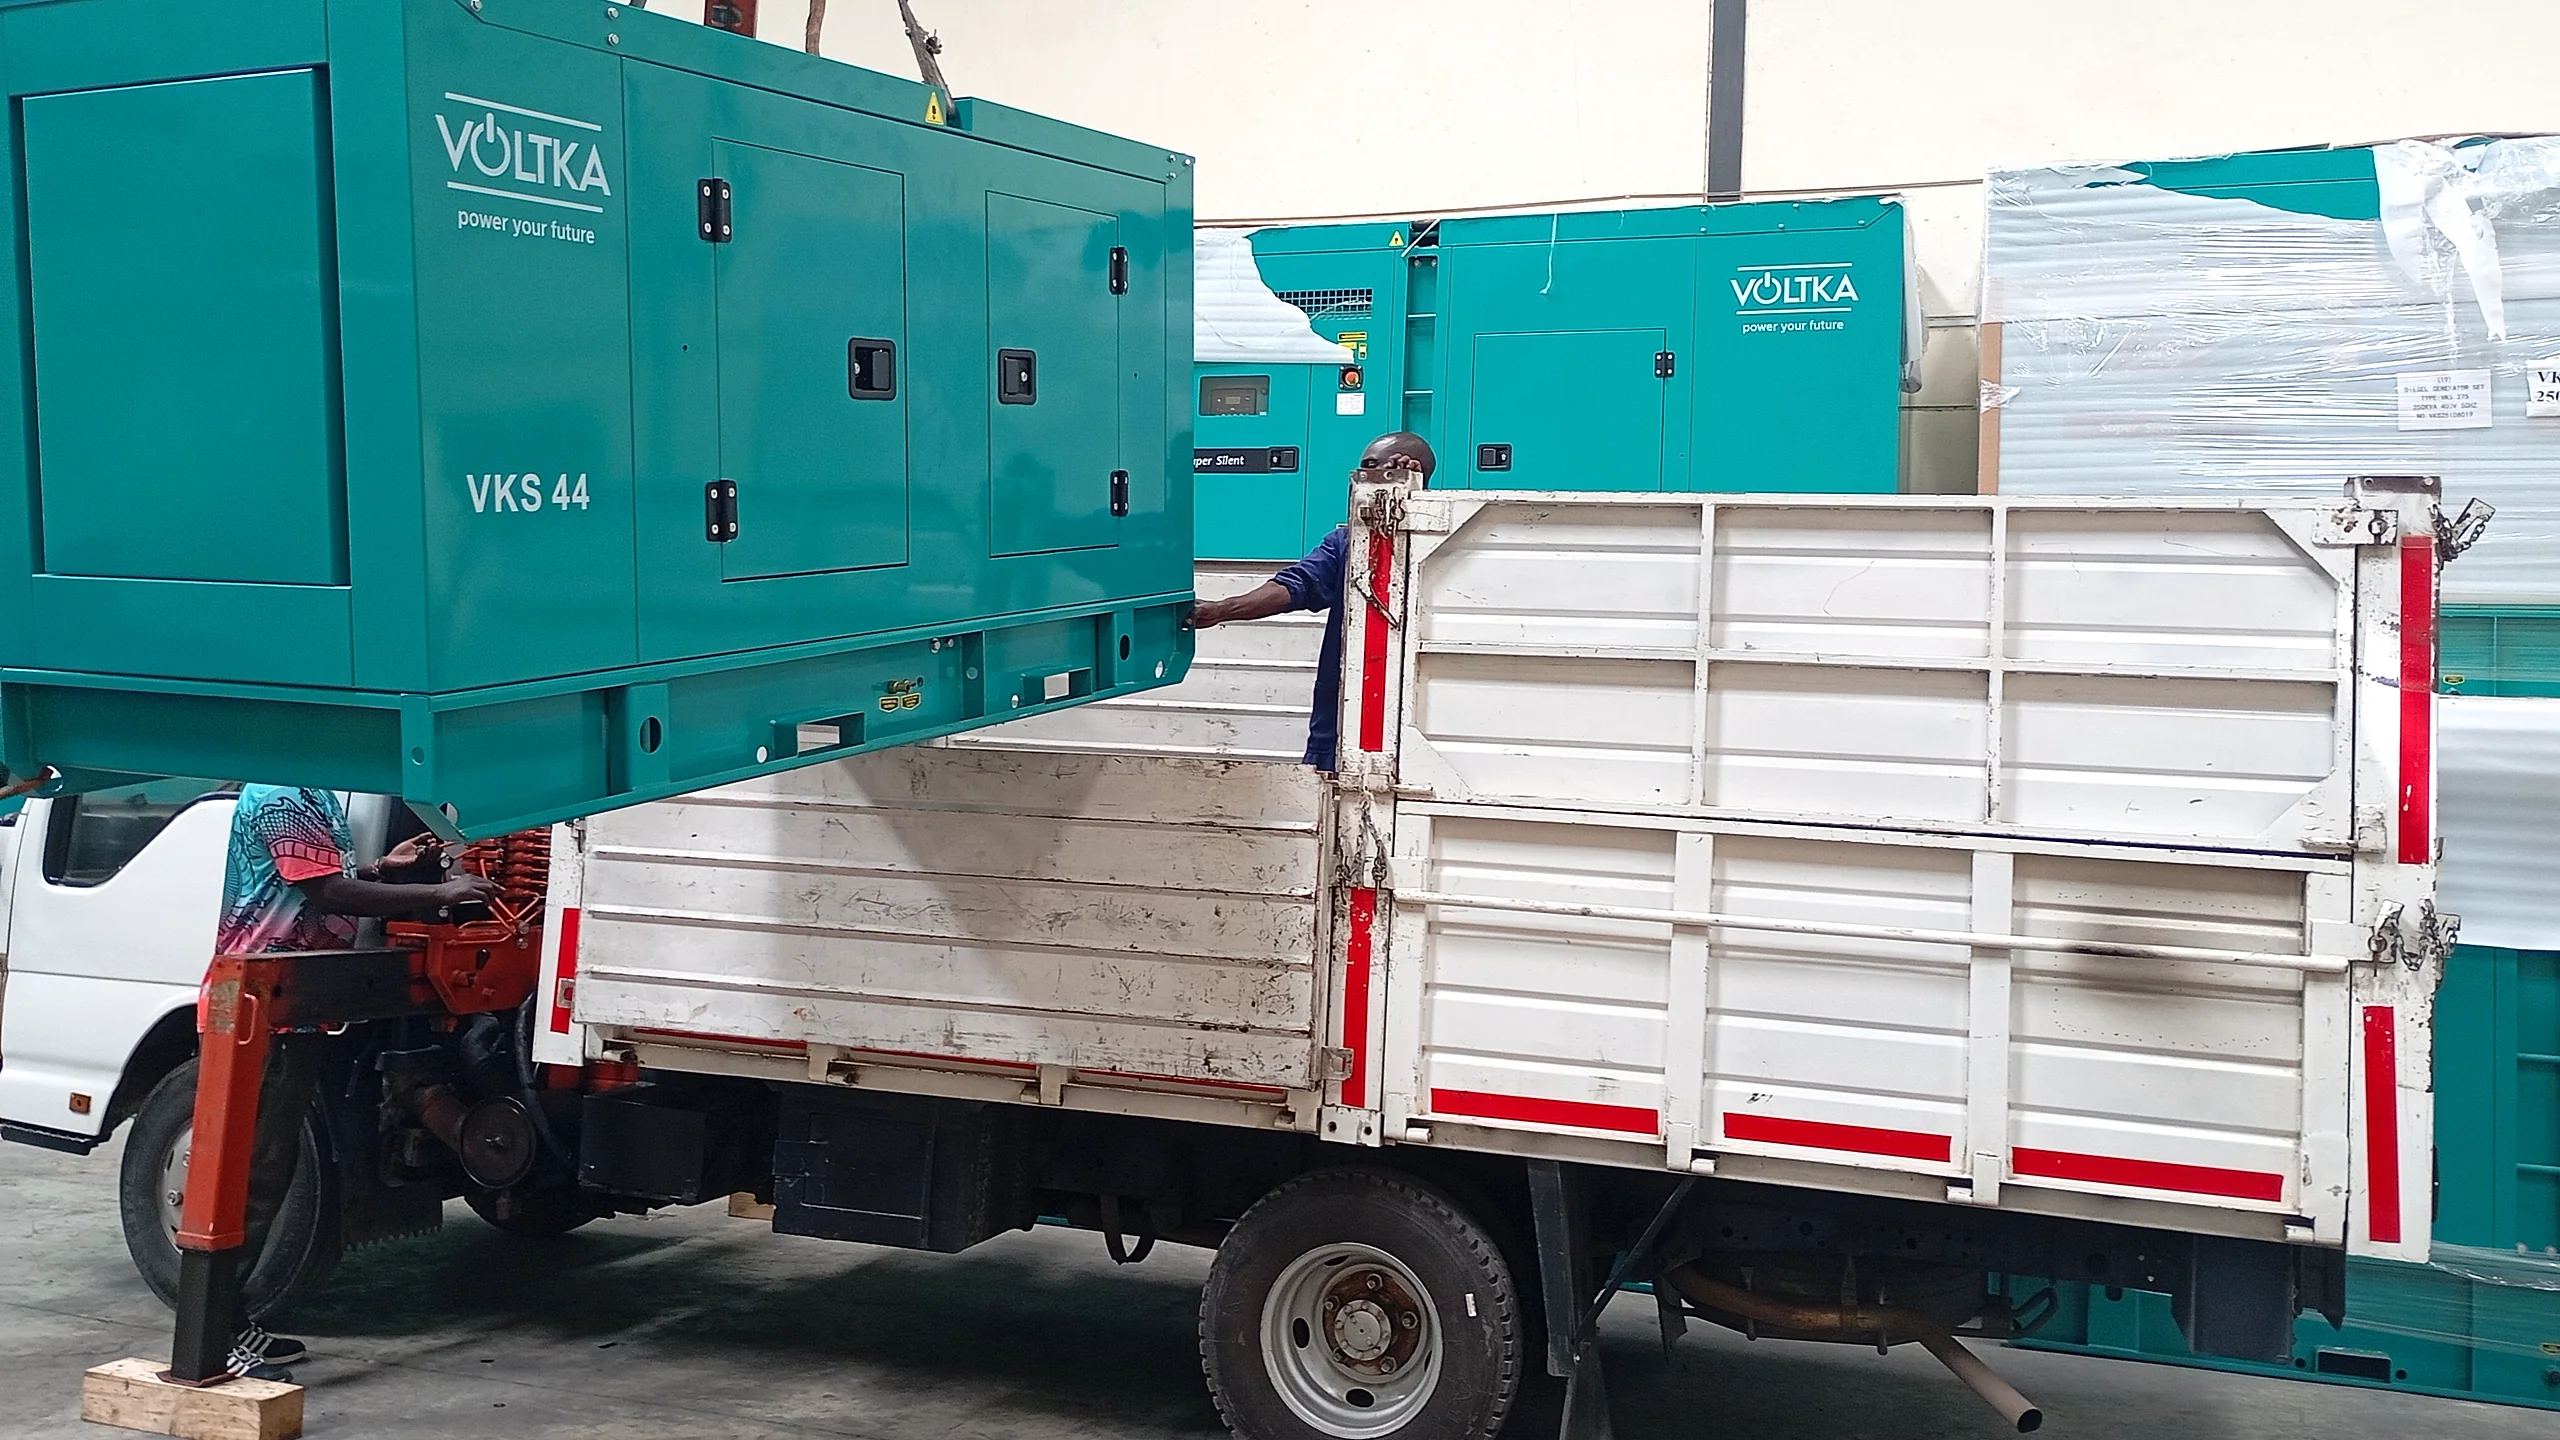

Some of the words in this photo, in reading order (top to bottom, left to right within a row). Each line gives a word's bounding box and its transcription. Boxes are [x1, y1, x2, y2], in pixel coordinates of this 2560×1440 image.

[434, 112, 612, 197] VOLTKA
[457, 209, 509, 231] power
[511, 217, 548, 238] your
[550, 220, 596, 245] future
[1729, 271, 1860, 307] VOLTKA
[1742, 321, 1778, 335] power
[1780, 321, 1807, 334] your
[1809, 319, 1845, 331] future
[2100, 422, 2137, 435] Super
[1215, 455, 1245, 466] Silent
[466, 473, 542, 513] VKS
[551, 473, 590, 511] 44
